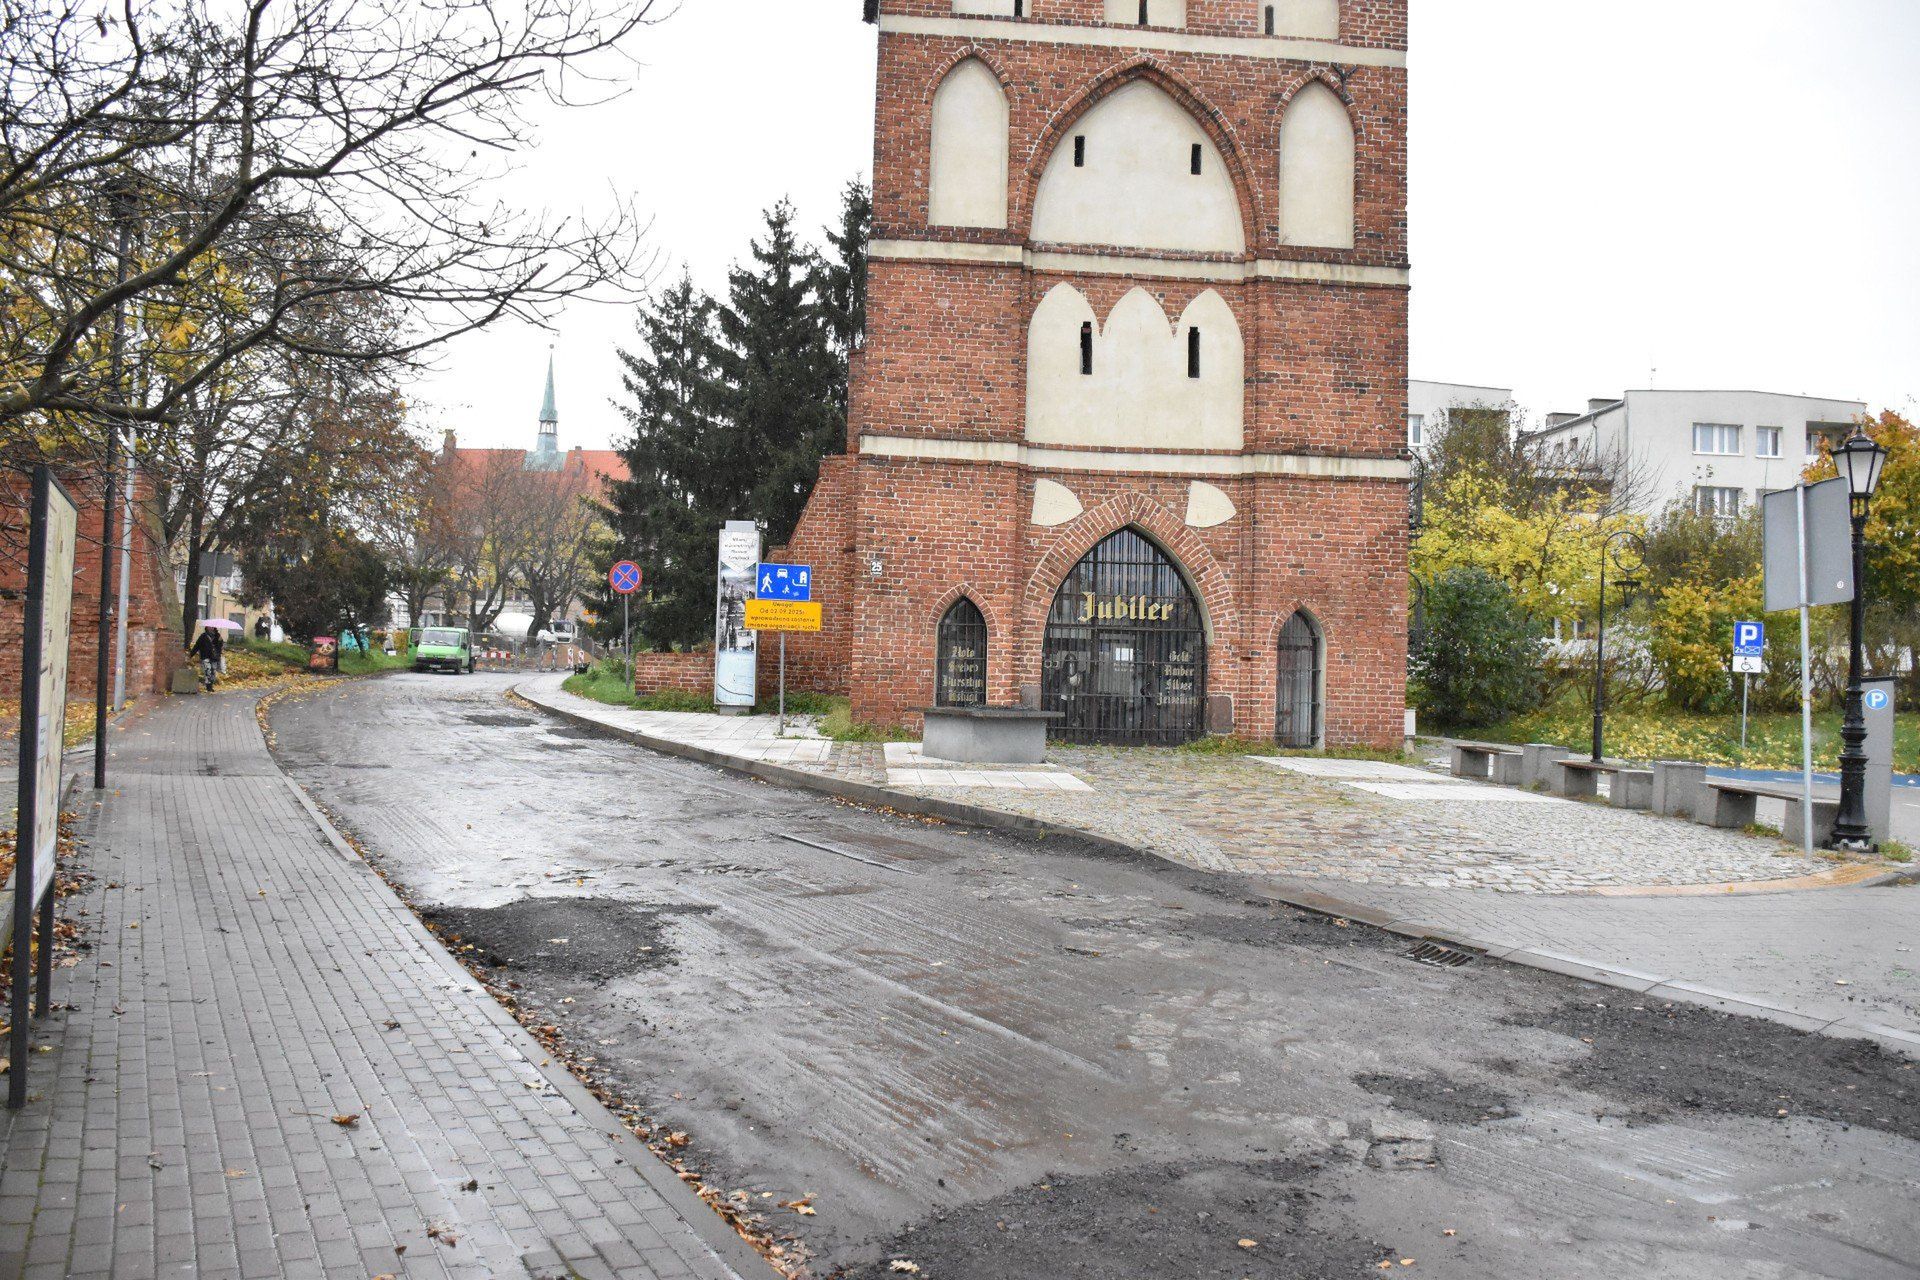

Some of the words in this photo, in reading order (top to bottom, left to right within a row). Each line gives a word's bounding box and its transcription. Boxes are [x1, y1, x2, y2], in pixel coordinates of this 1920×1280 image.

[871, 561, 882, 572] 25
[1077, 591, 1174, 622] Jubiler
[1741, 625, 1757, 646] P
[1871, 692, 1884, 707] P
